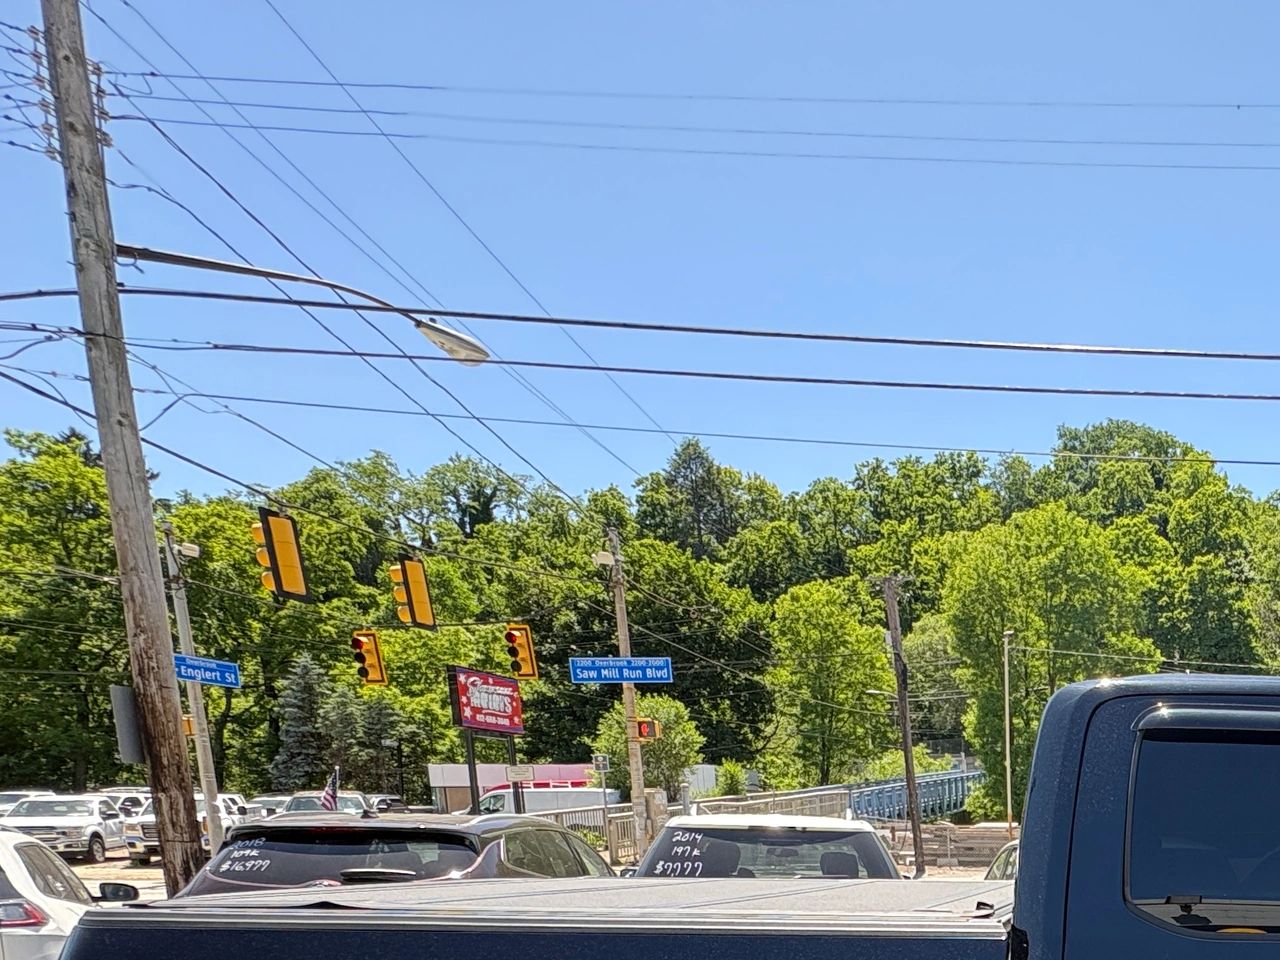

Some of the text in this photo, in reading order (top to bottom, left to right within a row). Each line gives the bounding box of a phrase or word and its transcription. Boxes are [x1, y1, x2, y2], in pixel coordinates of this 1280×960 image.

[180, 665, 237, 683] Englert St
[576, 668, 667, 678] Saw Mill Run Blvd
[672, 831, 703, 843] 2014
